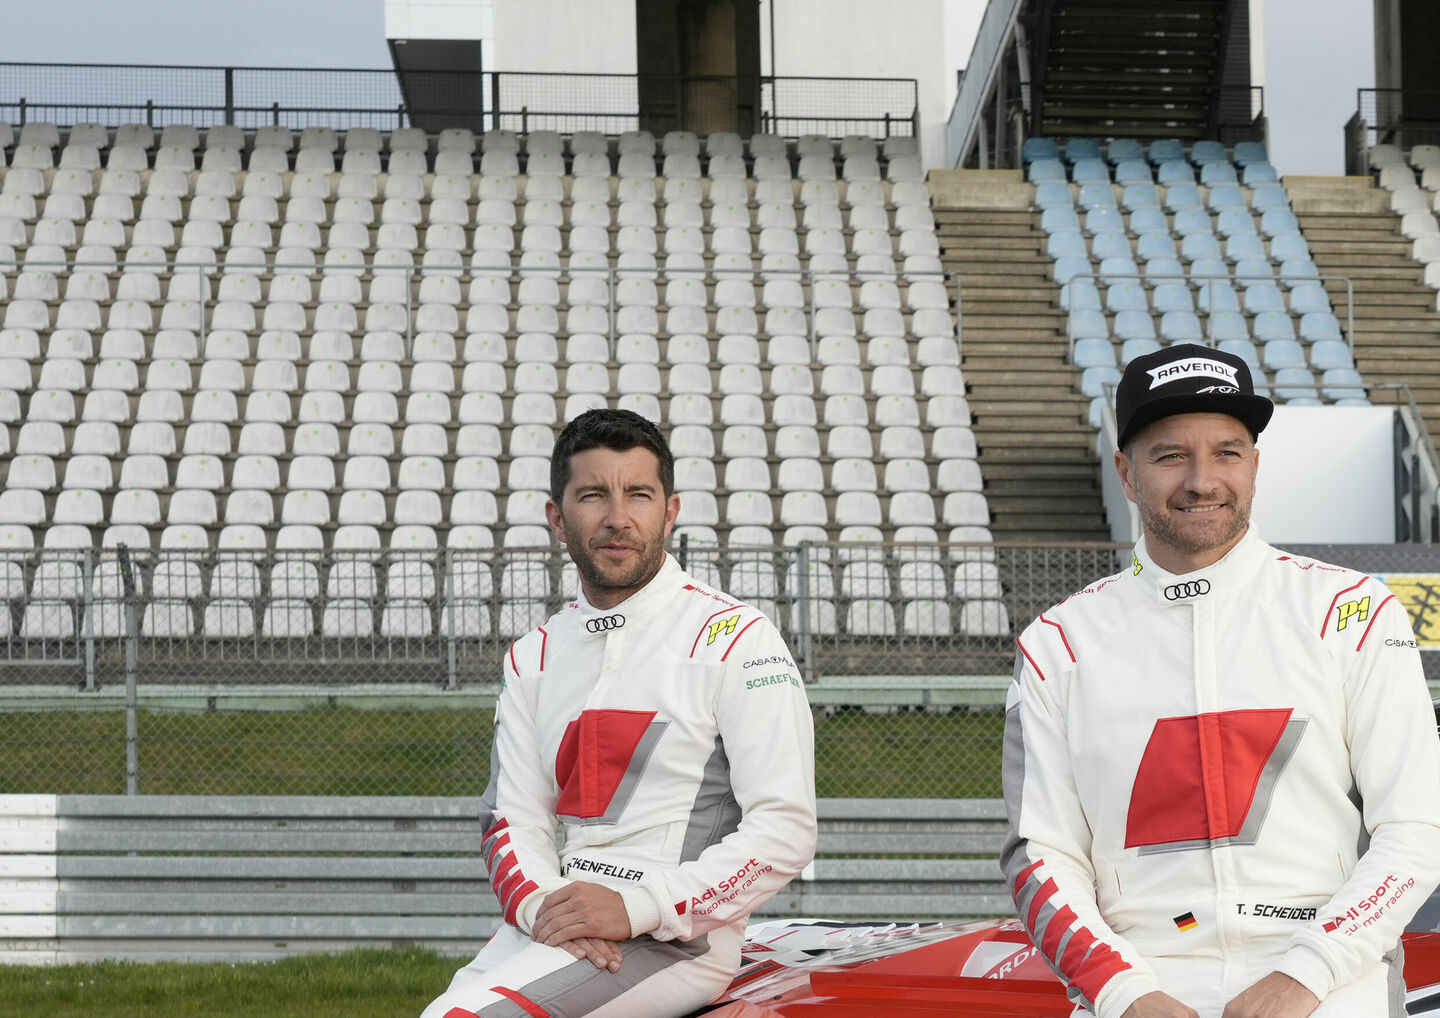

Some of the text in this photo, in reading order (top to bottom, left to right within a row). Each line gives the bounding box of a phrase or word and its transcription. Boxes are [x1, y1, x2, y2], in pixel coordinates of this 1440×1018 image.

[1158, 363, 1232, 380] RAVENOL
[707, 614, 741, 646] P1
[1336, 596, 1371, 632] P1
[691, 856, 759, 909] Adi Sport
[742, 864, 773, 891] racing
[1359, 873, 1398, 911] Sport
[1385, 876, 1416, 909] racing
[1236, 904, 1317, 920] T. SCHEIDER
